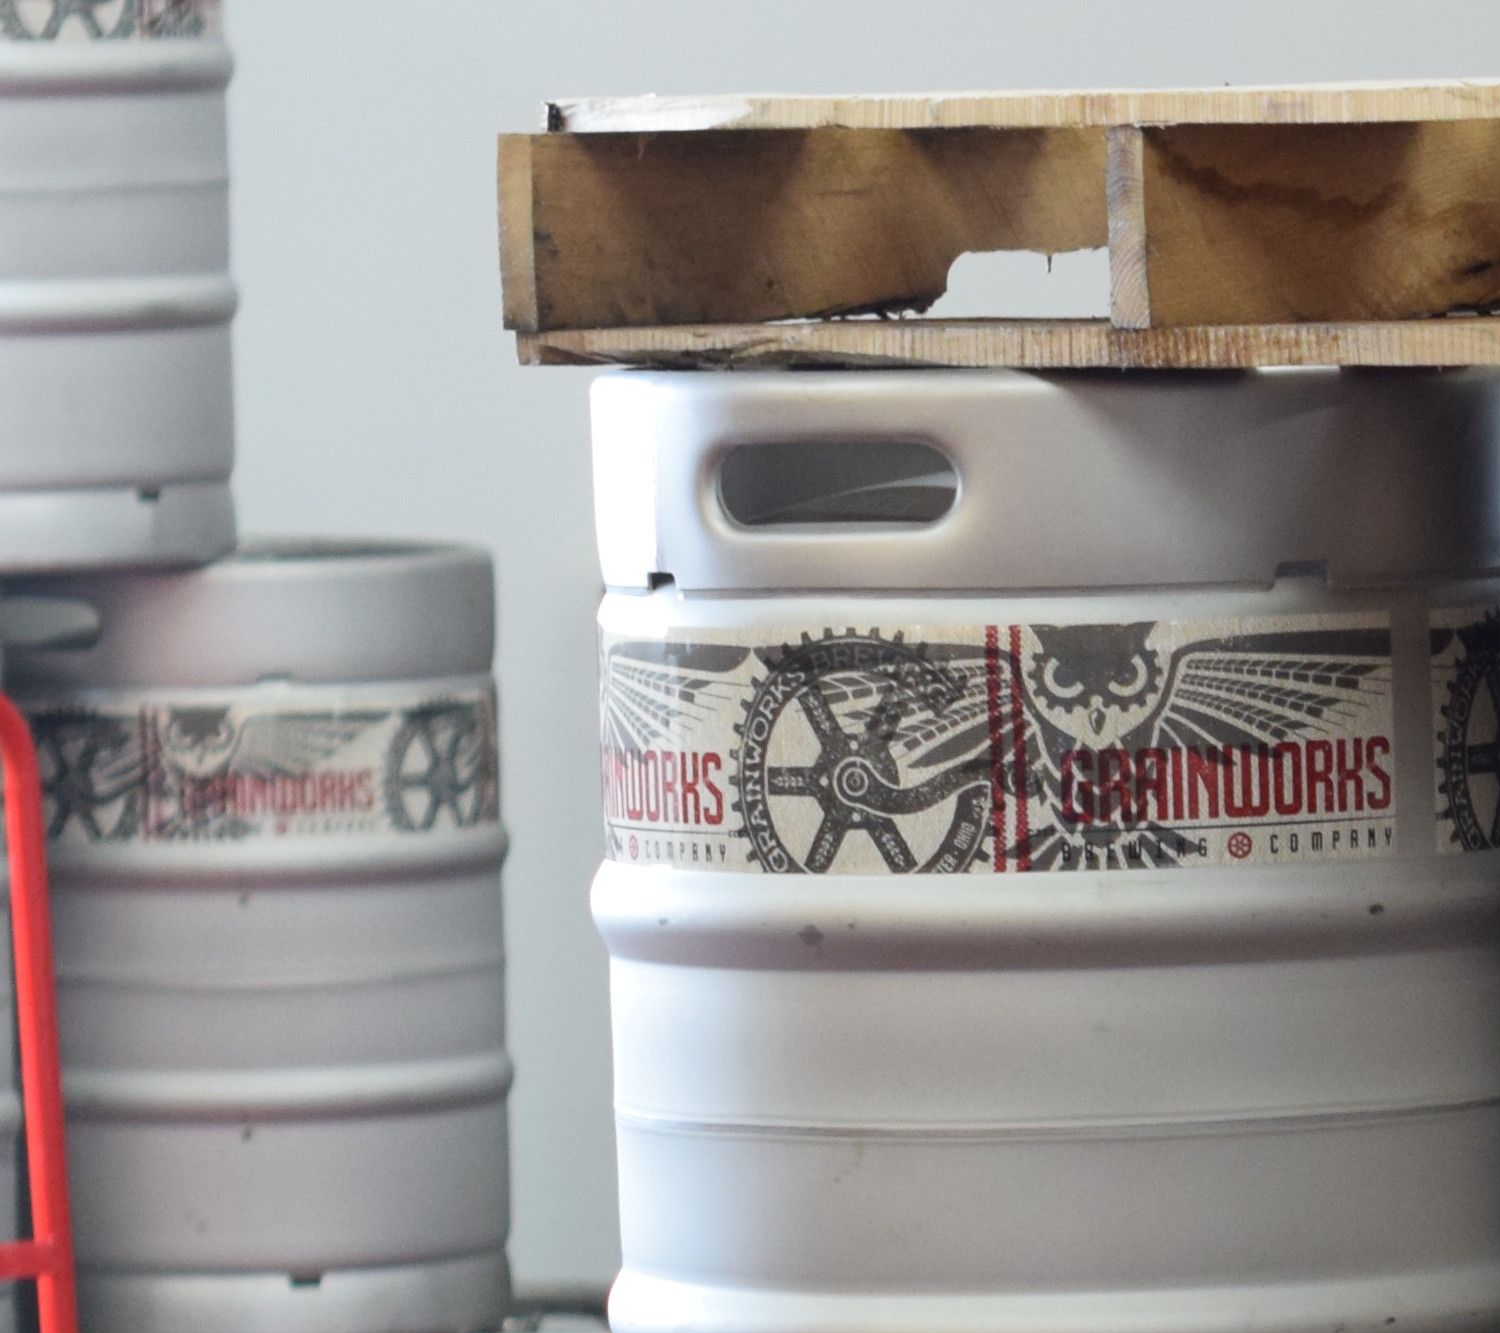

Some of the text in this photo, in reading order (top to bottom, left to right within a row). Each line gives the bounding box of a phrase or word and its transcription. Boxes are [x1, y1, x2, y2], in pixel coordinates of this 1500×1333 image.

[604, 745, 725, 827] NWORKS
[743, 663, 807, 873] GRAINWORKS
[1060, 734, 1392, 824] GRAINWORKS
[1061, 826, 1395, 862] BREWING COMPANY
